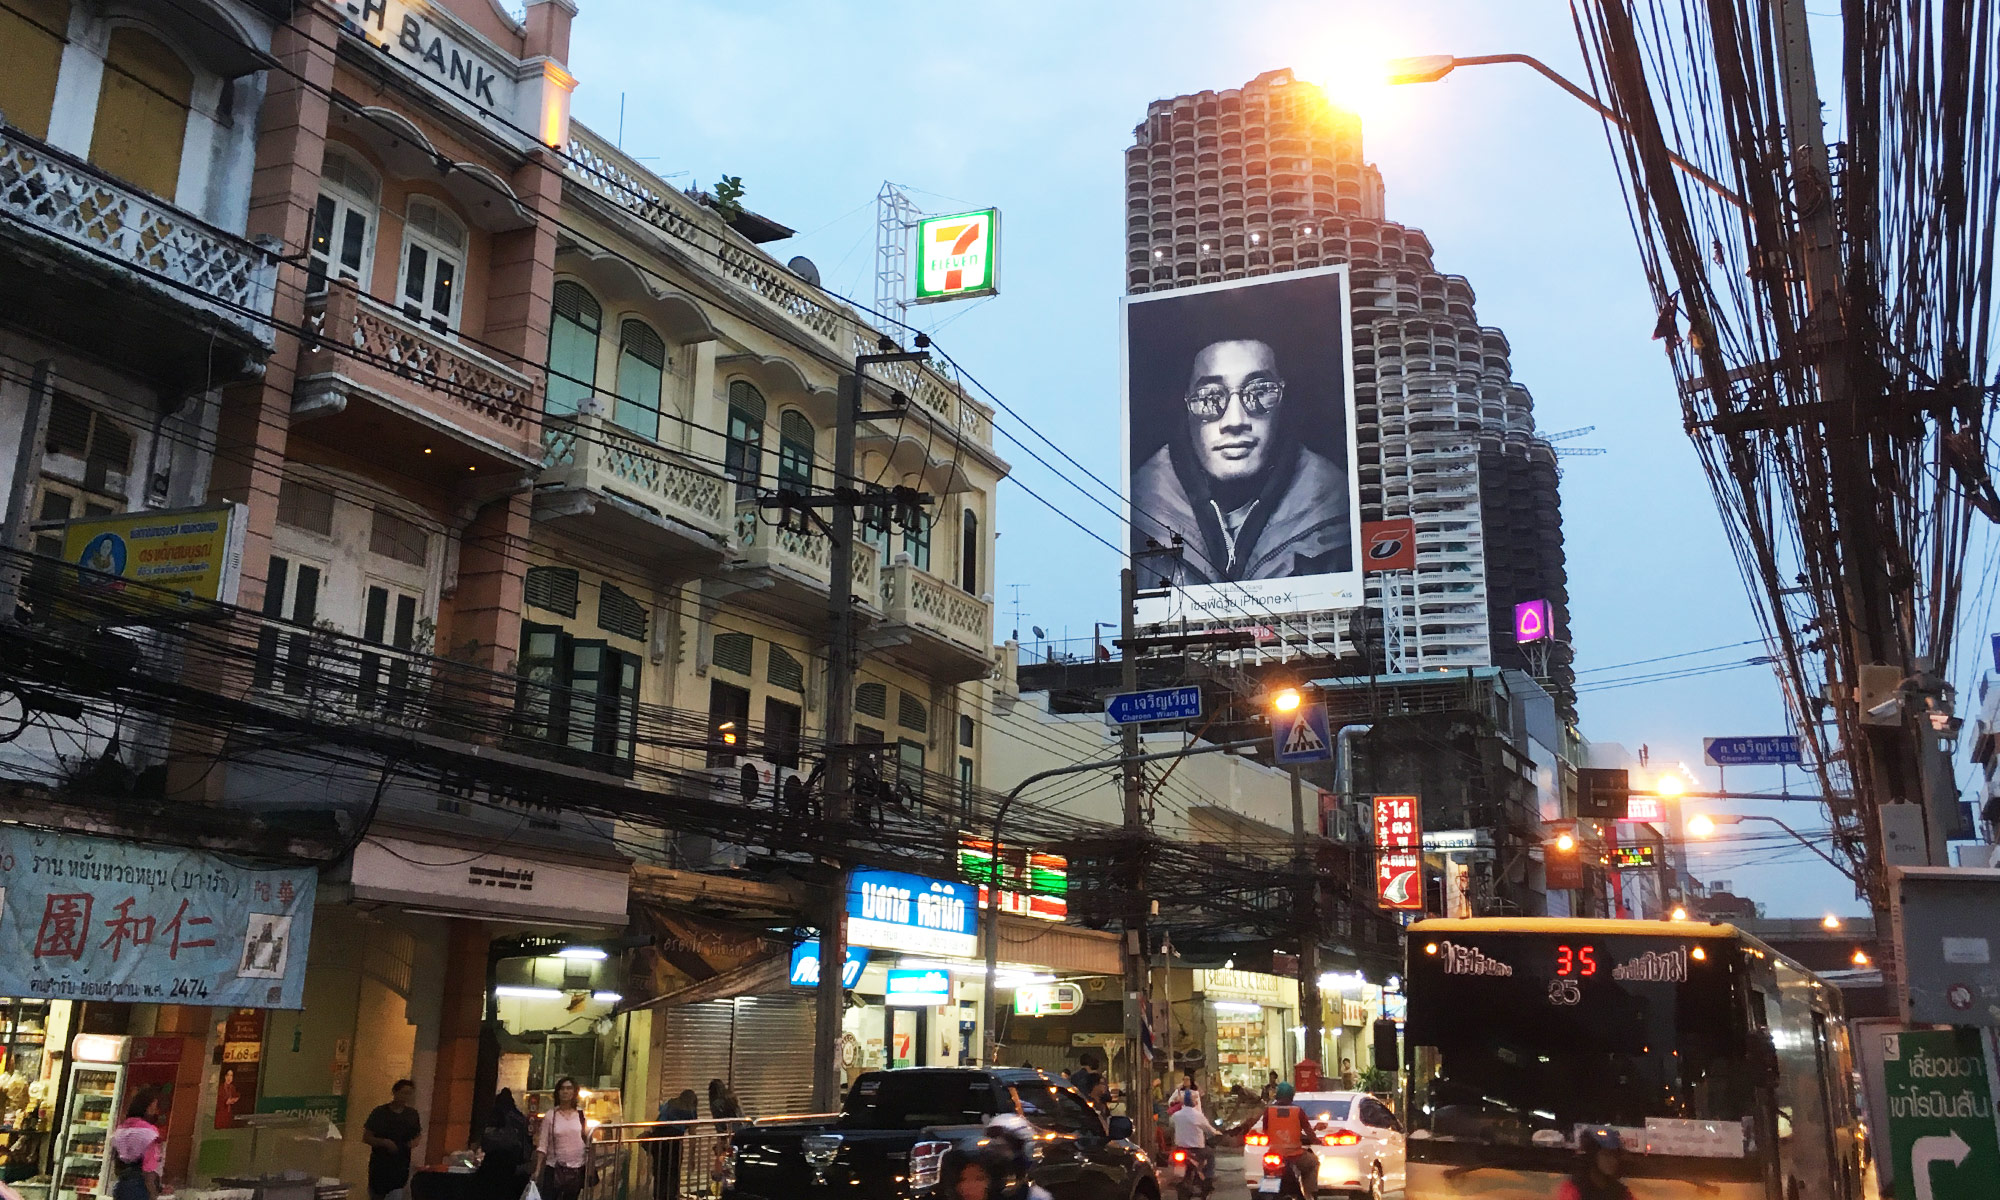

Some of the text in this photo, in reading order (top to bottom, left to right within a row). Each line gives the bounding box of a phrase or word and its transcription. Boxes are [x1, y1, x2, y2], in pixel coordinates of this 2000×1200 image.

[399, 14, 495, 106] BANK
[935, 223, 980, 290] 7
[1240, 594, 1281, 607] iPhone
[1284, 592, 1292, 603] X
[1135, 690, 1197, 711] เจริญเวียง
[1156, 710, 1179, 718] Wiang
[32, 838, 64, 876] ร้าน
[862, 882, 965, 932] บงกช คลินิก
[1441, 941, 1513, 977] พระประแดง
[1557, 945, 1597, 976] 35
[169, 978, 210, 998] 2474
[1909, 1047, 1982, 1077] เลี้ยวขวา
[1890, 1083, 1989, 1118] เข้าโรบินสัน
